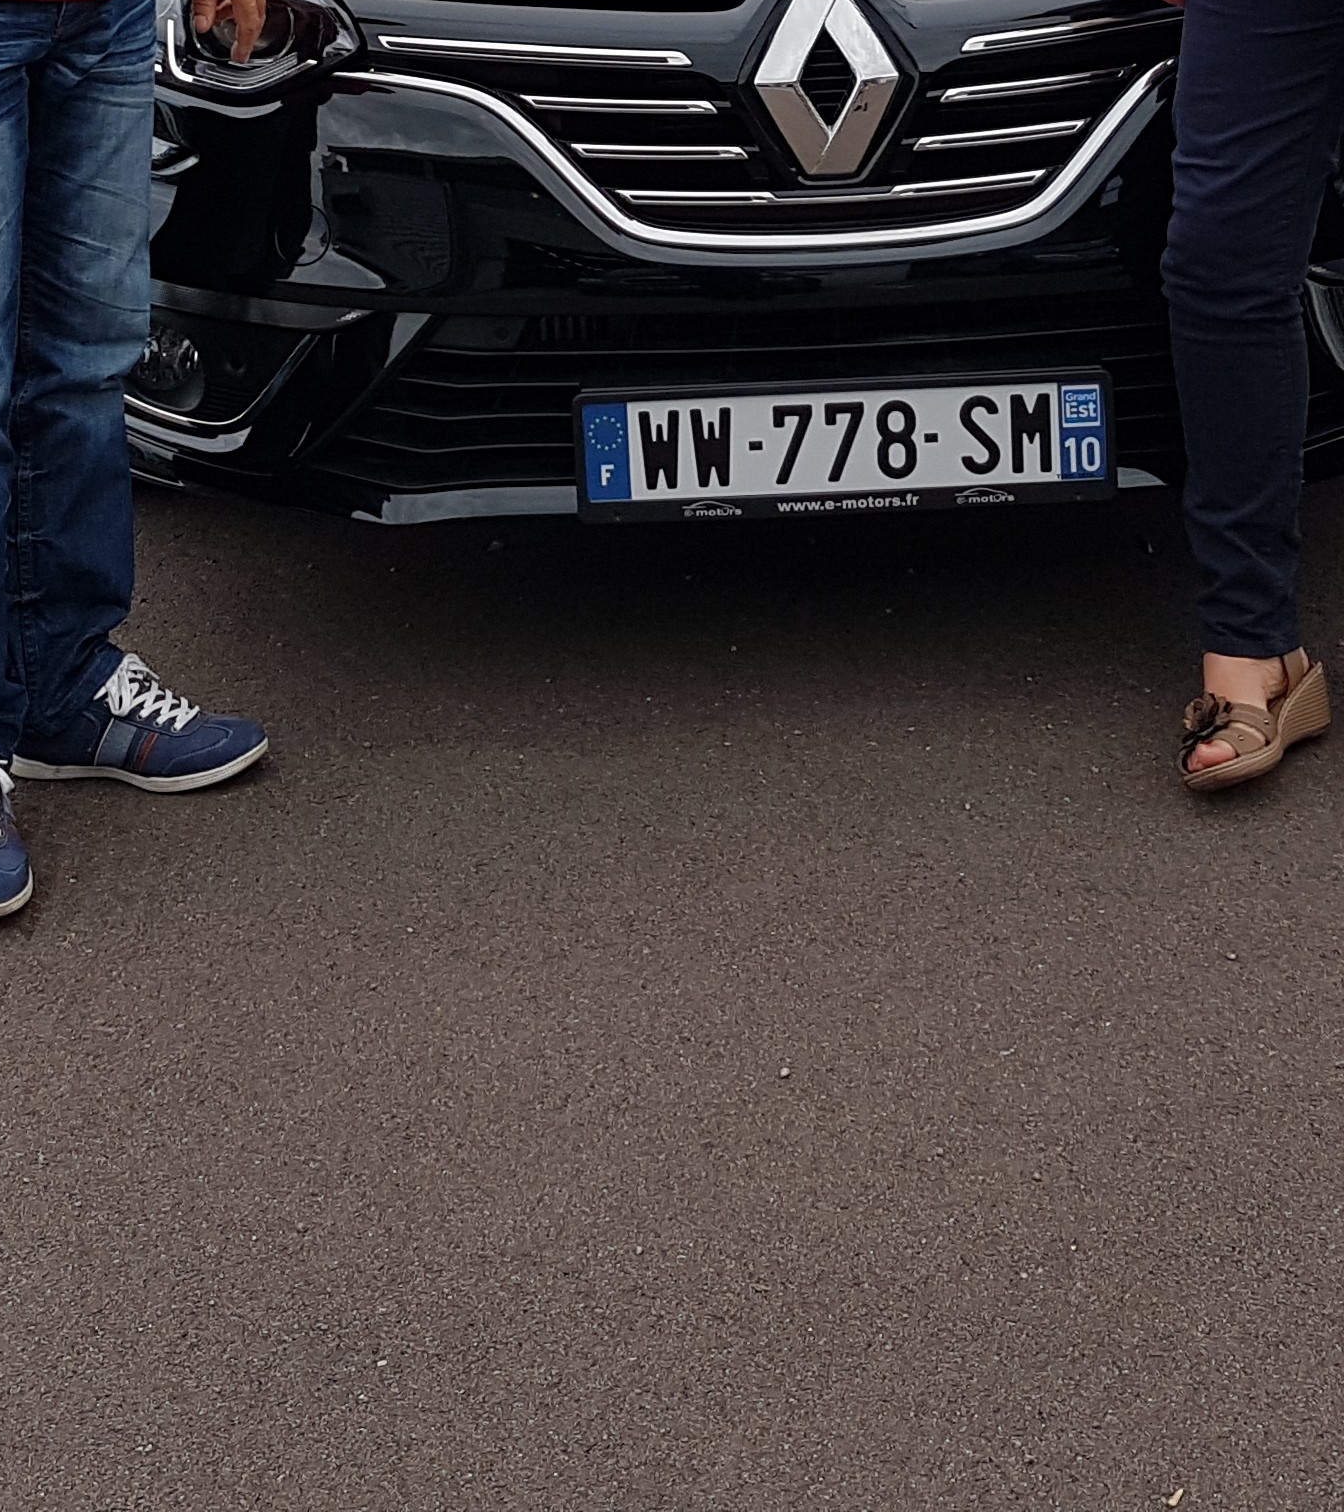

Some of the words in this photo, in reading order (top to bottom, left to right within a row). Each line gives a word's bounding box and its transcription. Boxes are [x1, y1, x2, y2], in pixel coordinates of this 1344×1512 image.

[1065, 391, 1097, 402] Grand
[1065, 401, 1097, 418] Est
[637, 392, 1053, 491] WW-778-SM
[1064, 436, 1101, 473] 10
[600, 464, 615, 486] F
[777, 493, 920, 513] www.e-motors.fr
